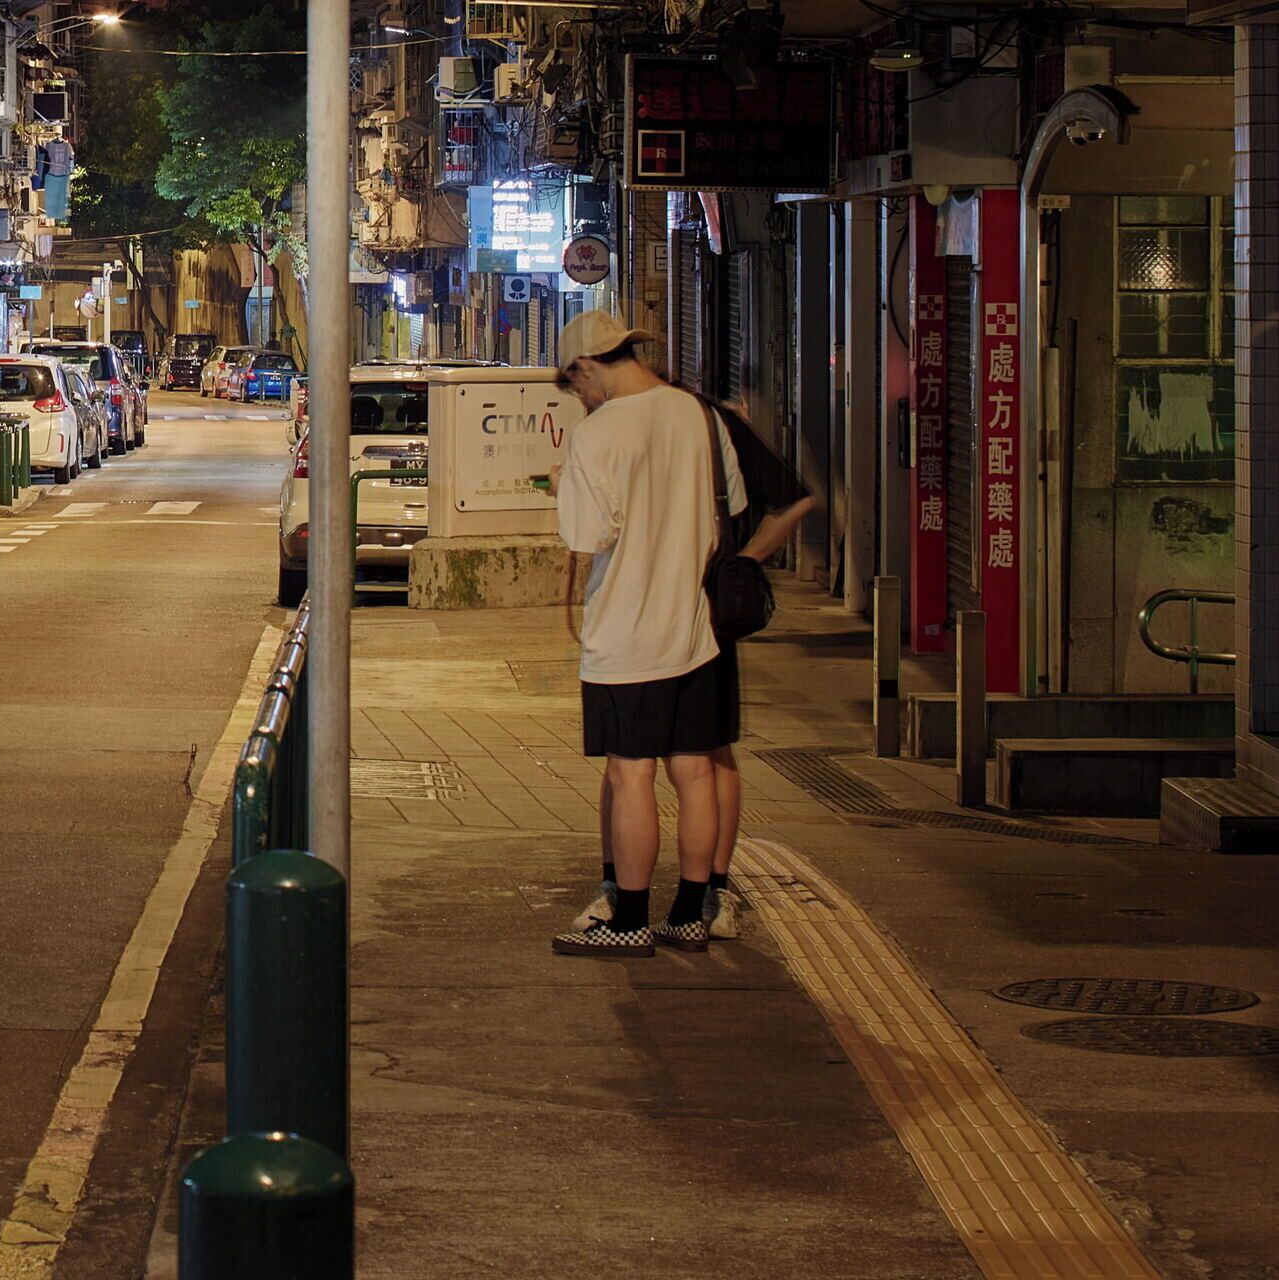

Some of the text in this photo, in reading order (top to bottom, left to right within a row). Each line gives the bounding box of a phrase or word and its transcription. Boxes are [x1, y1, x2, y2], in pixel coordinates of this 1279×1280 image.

[481, 414, 537, 435] CTM
[920, 329, 944, 531] 處方配藥處
[988, 342, 1015, 569] 處方配藥處
